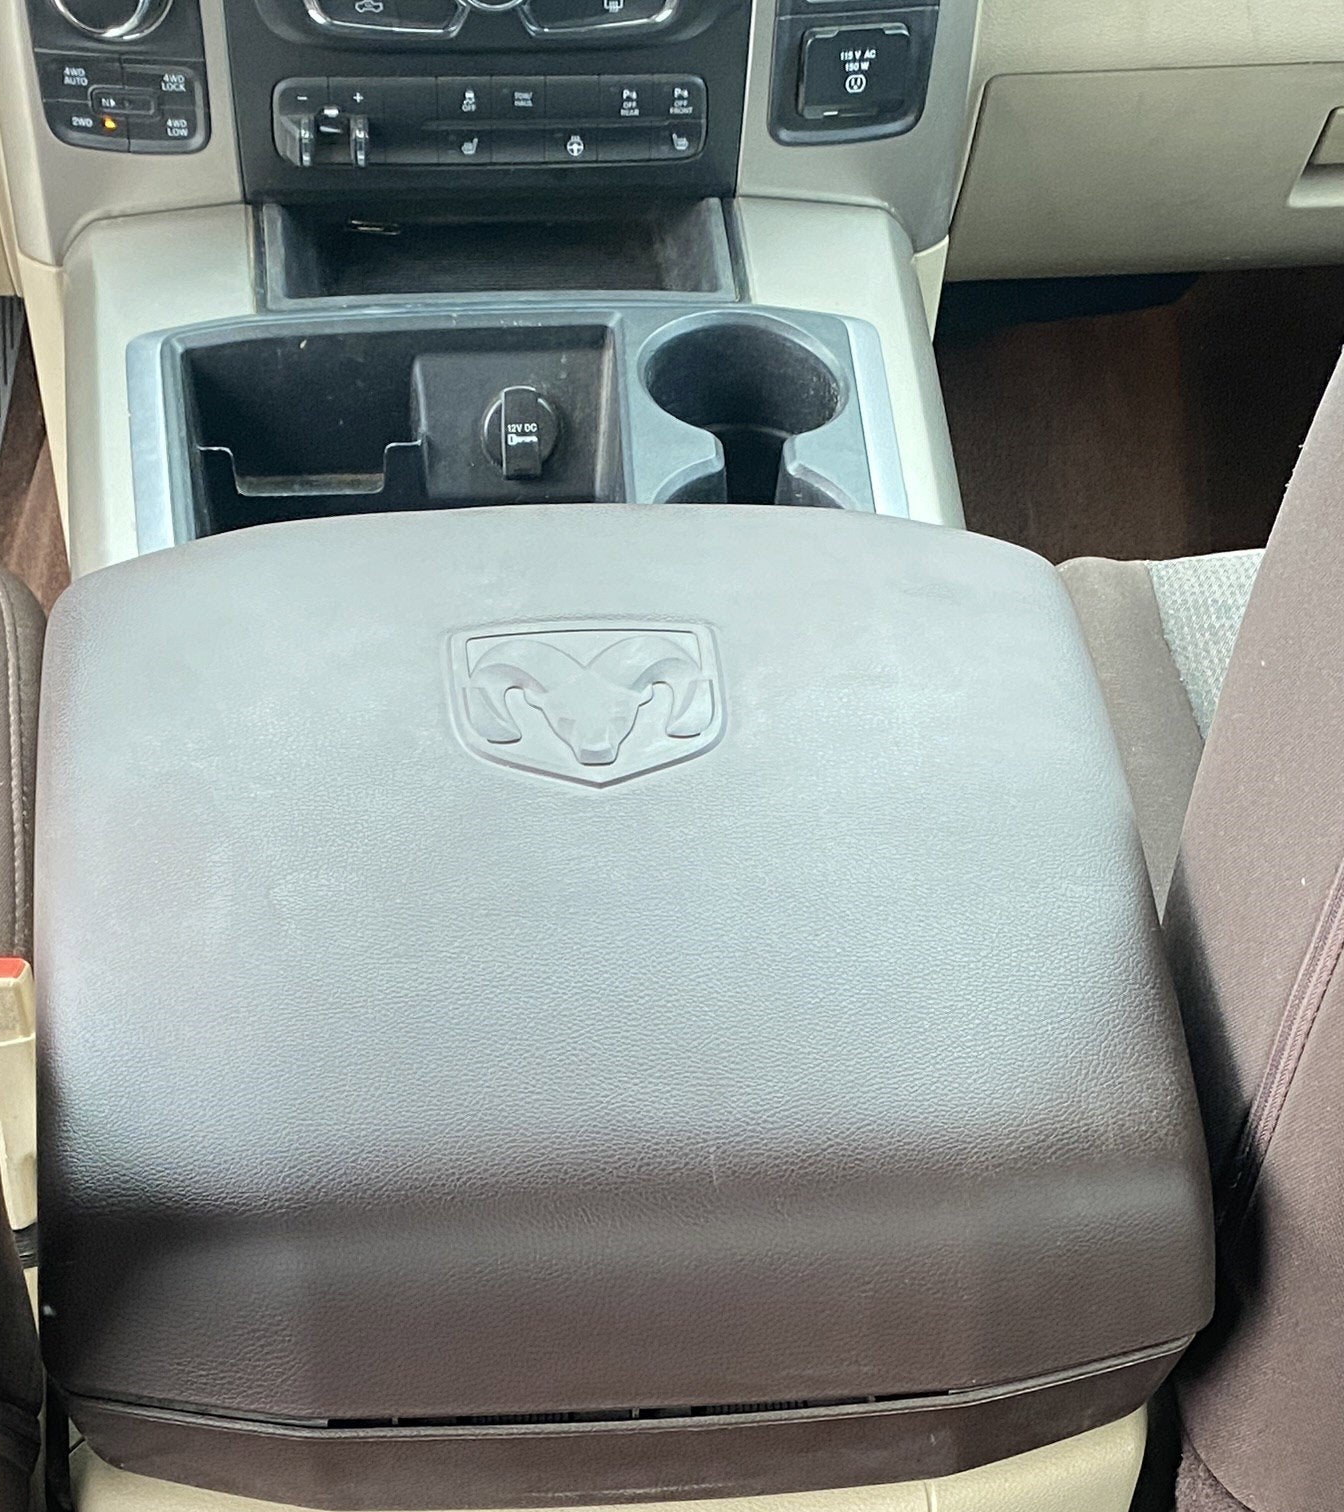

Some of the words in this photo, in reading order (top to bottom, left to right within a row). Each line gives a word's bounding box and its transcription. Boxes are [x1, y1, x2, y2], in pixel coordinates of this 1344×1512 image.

[840, 50, 854, 61] 115
[854, 50, 862, 60] V
[863, 49, 877, 59] AC
[64, 67, 86, 77] 4WD
[845, 62, 860, 72] 150
[860, 61, 870, 71] W
[63, 76, 89, 87] AUTO
[163, 73, 186, 84] 4WD
[161, 82, 187, 92] LOCK
[71, 116, 94, 128] 2WD
[166, 118, 188, 128] 4WD
[167, 127, 189, 137] LOW
[507, 423, 523, 433] 12V
[524, 422, 538, 433] DC
